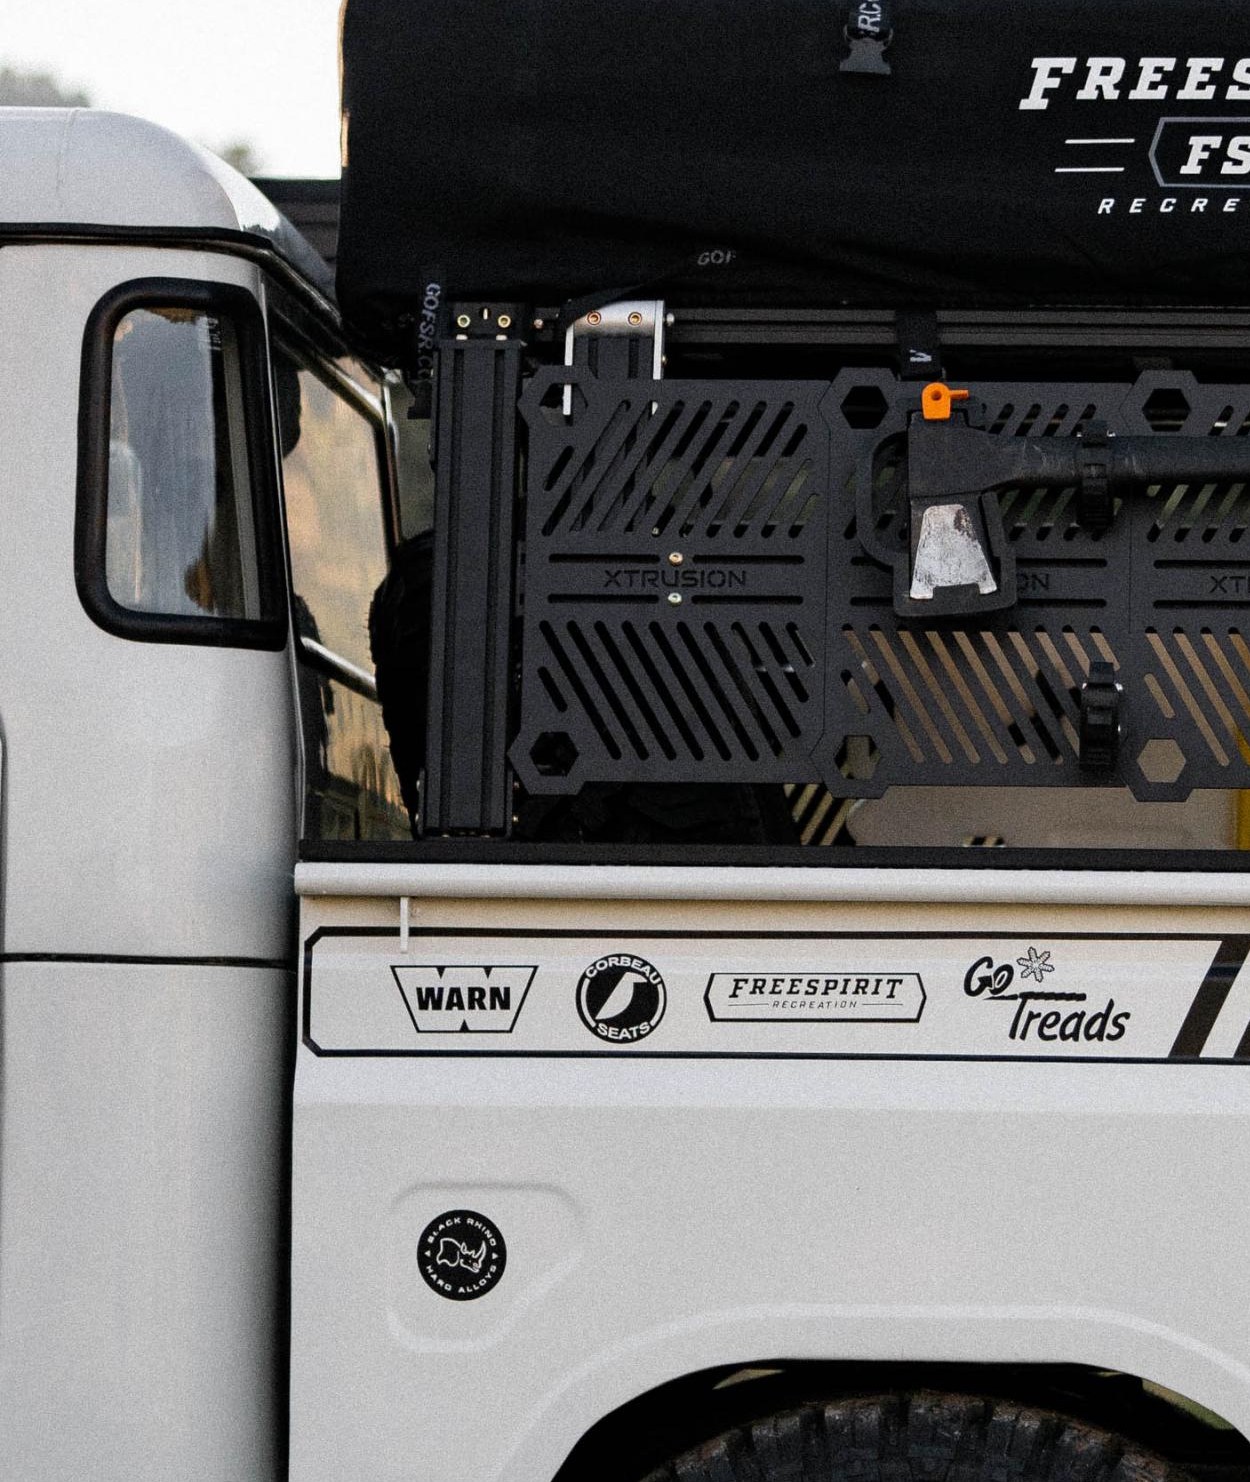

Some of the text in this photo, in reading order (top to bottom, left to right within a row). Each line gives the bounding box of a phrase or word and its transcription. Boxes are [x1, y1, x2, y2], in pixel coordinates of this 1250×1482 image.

[603, 569, 747, 589] XTRUSION
[585, 956, 662, 986] CORBEAU
[416, 986, 511, 1010] WARN
[729, 978, 904, 999] FREESPIRIT
[772, 1000, 858, 1009] RECREATION
[1009, 992, 1131, 1042] Treads
[597, 1021, 651, 1040] SEATS
[427, 1217, 497, 1247] BLACK RHINO
[426, 1264, 497, 1293] HARD ALLOYS
